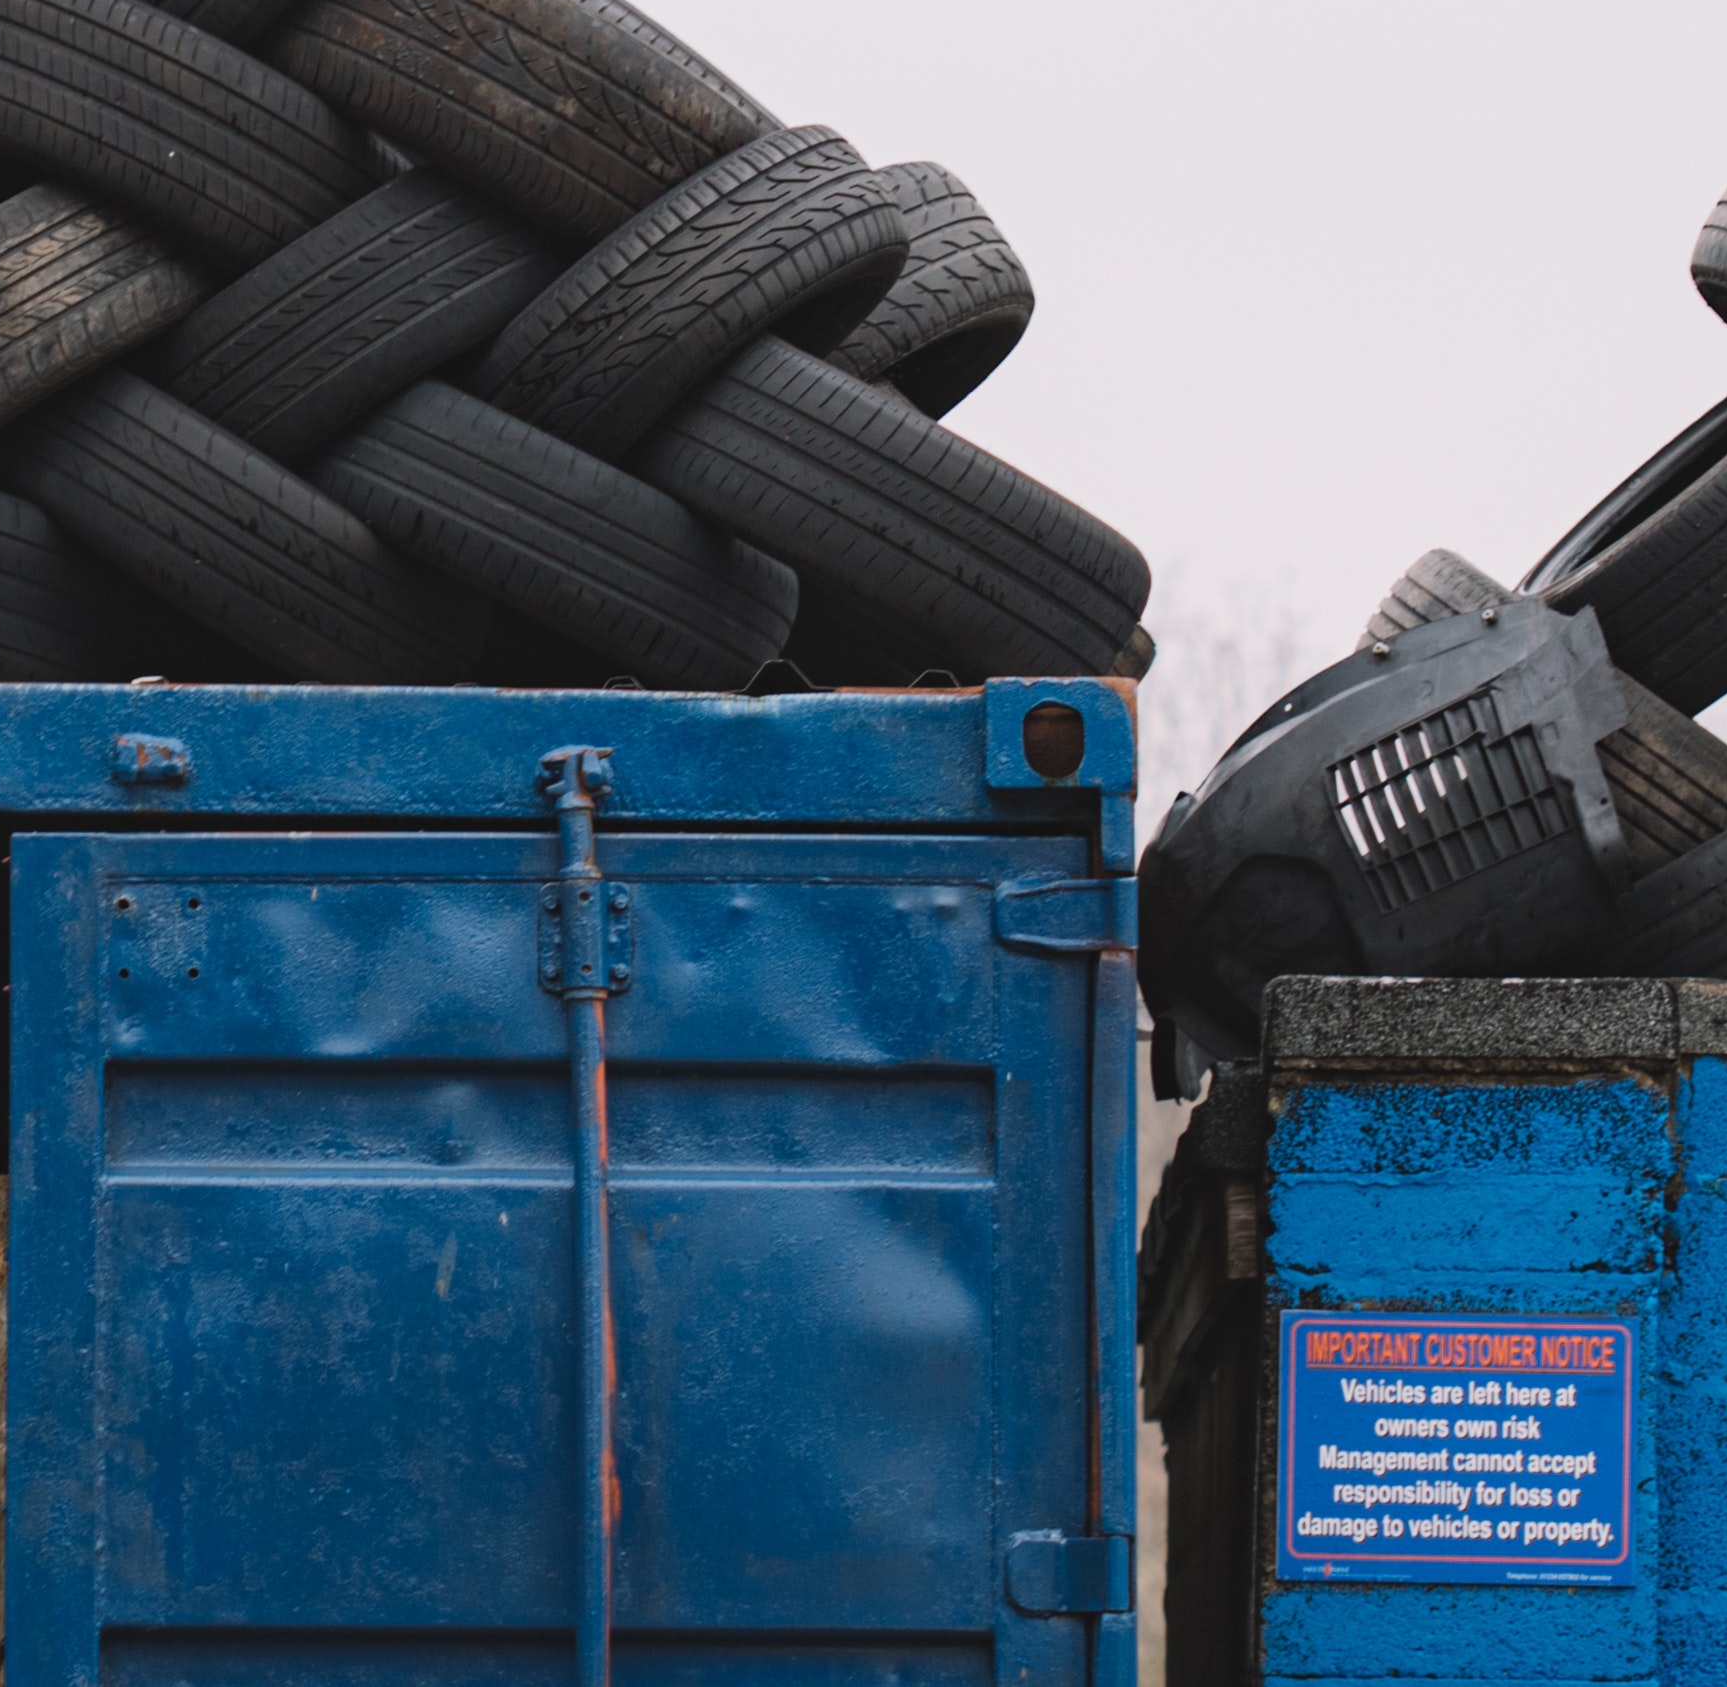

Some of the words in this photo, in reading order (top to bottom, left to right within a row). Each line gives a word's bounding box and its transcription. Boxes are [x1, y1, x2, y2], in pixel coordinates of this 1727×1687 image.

[1307, 1332, 1420, 1364] IMPORTANT
[1425, 1334, 1537, 1367] CUSTOMER
[1541, 1336, 1615, 1369] NOTICE
[1341, 1379, 1426, 1403] Vehicles
[1431, 1386, 1464, 1405] are
[1468, 1381, 1502, 1406] left
[1506, 1382, 1551, 1407] here
[1556, 1384, 1577, 1407] at
[1375, 1418, 1450, 1438] owners
[1454, 1419, 1498, 1439] own
[1502, 1415, 1541, 1440] risk
[1319, 1444, 1450, 1477] Management
[1453, 1450, 1524, 1473] cannot
[1528, 1451, 1597, 1480] accept
[1334, 1480, 1472, 1511] responsibility
[1476, 1481, 1506, 1506] for
[1510, 1482, 1553, 1507] loss
[1558, 1488, 1581, 1507] or
[1298, 1511, 1379, 1543] damage
[1382, 1514, 1404, 1538] to
[1408, 1514, 1493, 1540] vehicles
[1497, 1521, 1520, 1540] or
[1524, 1518, 1615, 1548] property.
